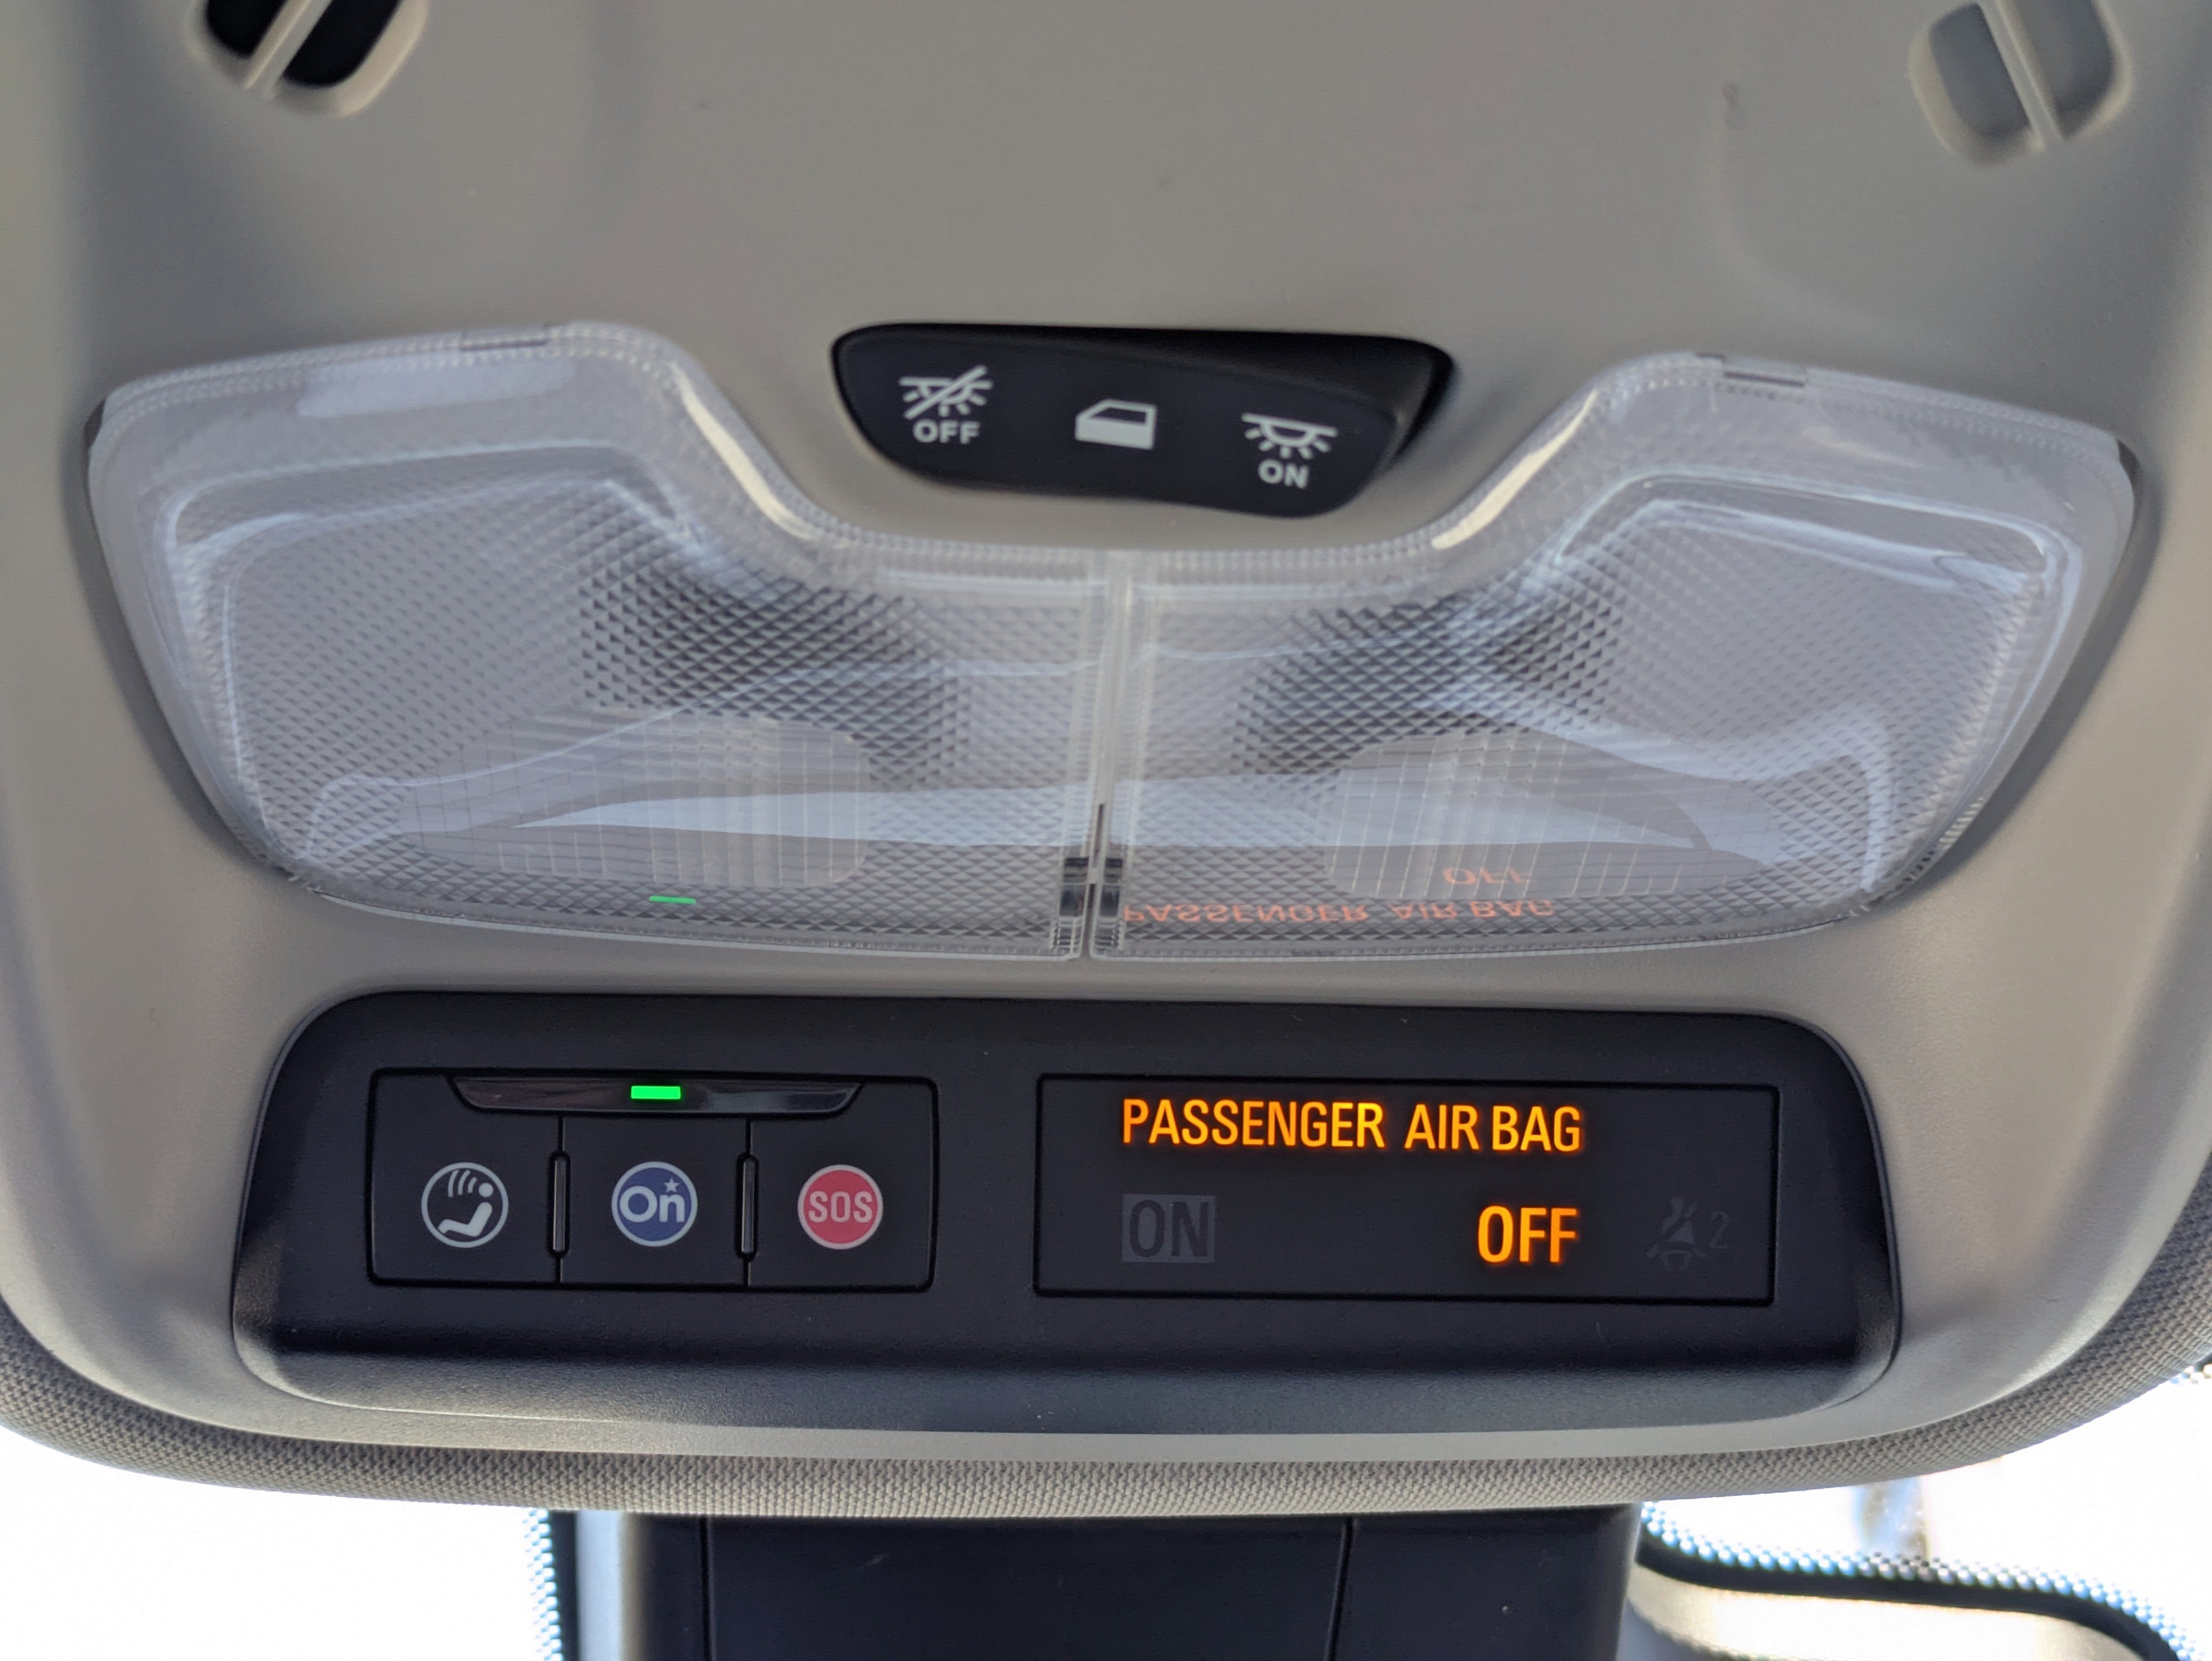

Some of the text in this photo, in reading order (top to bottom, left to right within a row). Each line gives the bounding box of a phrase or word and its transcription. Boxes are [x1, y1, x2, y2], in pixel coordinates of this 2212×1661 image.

[914, 420, 980, 444] OFF
[1259, 460, 1309, 488] ON
[1122, 1098, 1582, 1152] PASSENGER AIR BAG
[620, 1185, 685, 1223] On
[808, 1191, 873, 1223] SOS
[1128, 1199, 1210, 1258] ON
[1477, 1206, 1579, 1263] OFF
